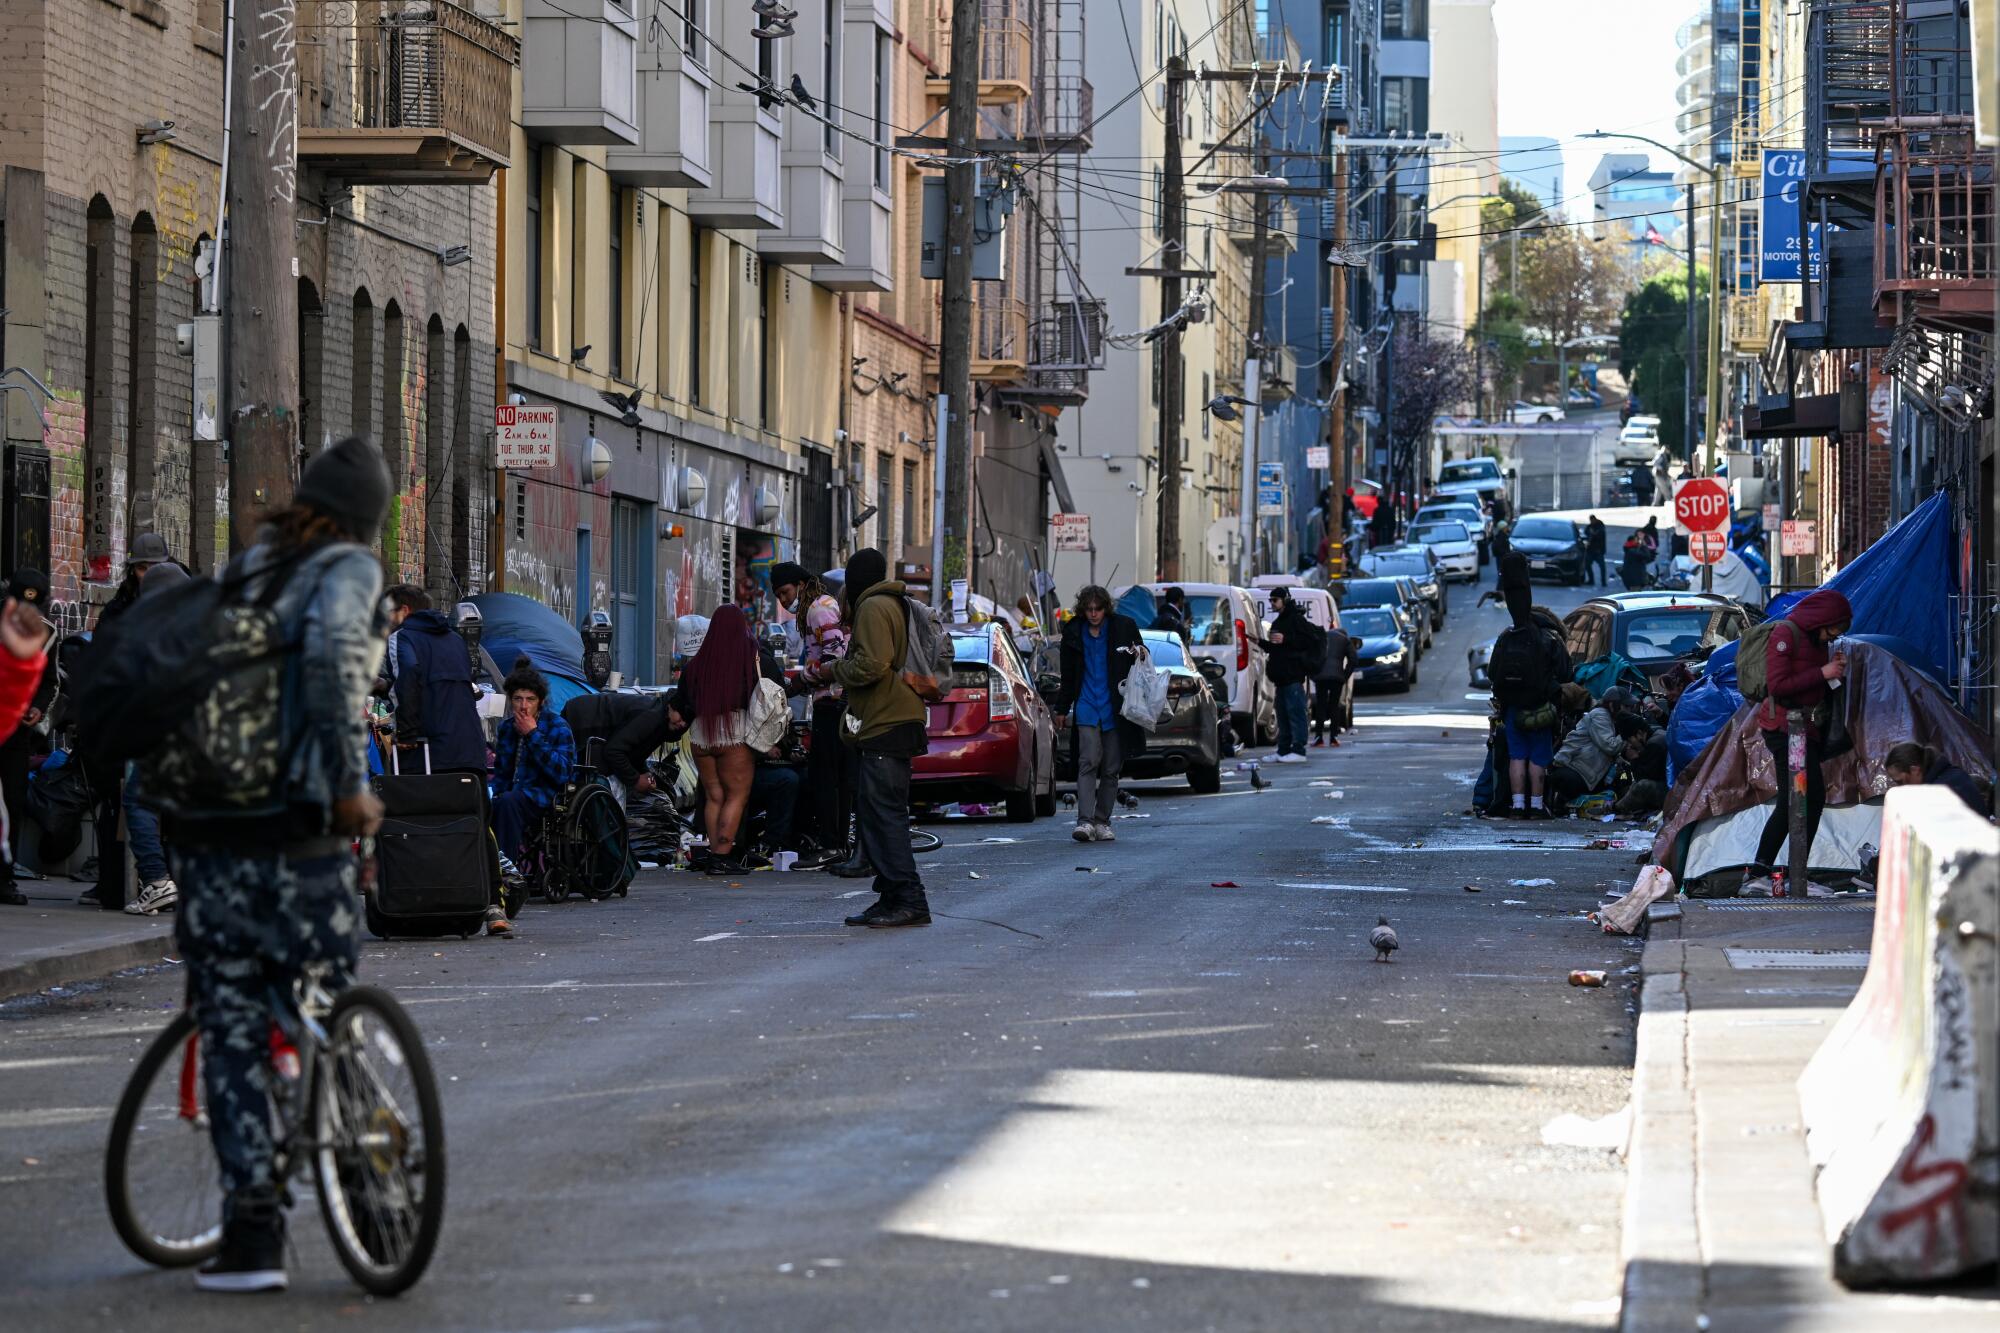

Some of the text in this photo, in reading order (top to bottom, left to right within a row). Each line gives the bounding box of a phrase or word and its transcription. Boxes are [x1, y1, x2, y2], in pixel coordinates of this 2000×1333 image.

[1767, 154, 1806, 177] Cit
[498, 407, 554, 424] NO PARKING
[503, 458, 550, 466] STREET CLEANING
[1678, 494, 1725, 518] STOP
[1783, 522, 1794, 532] NO
